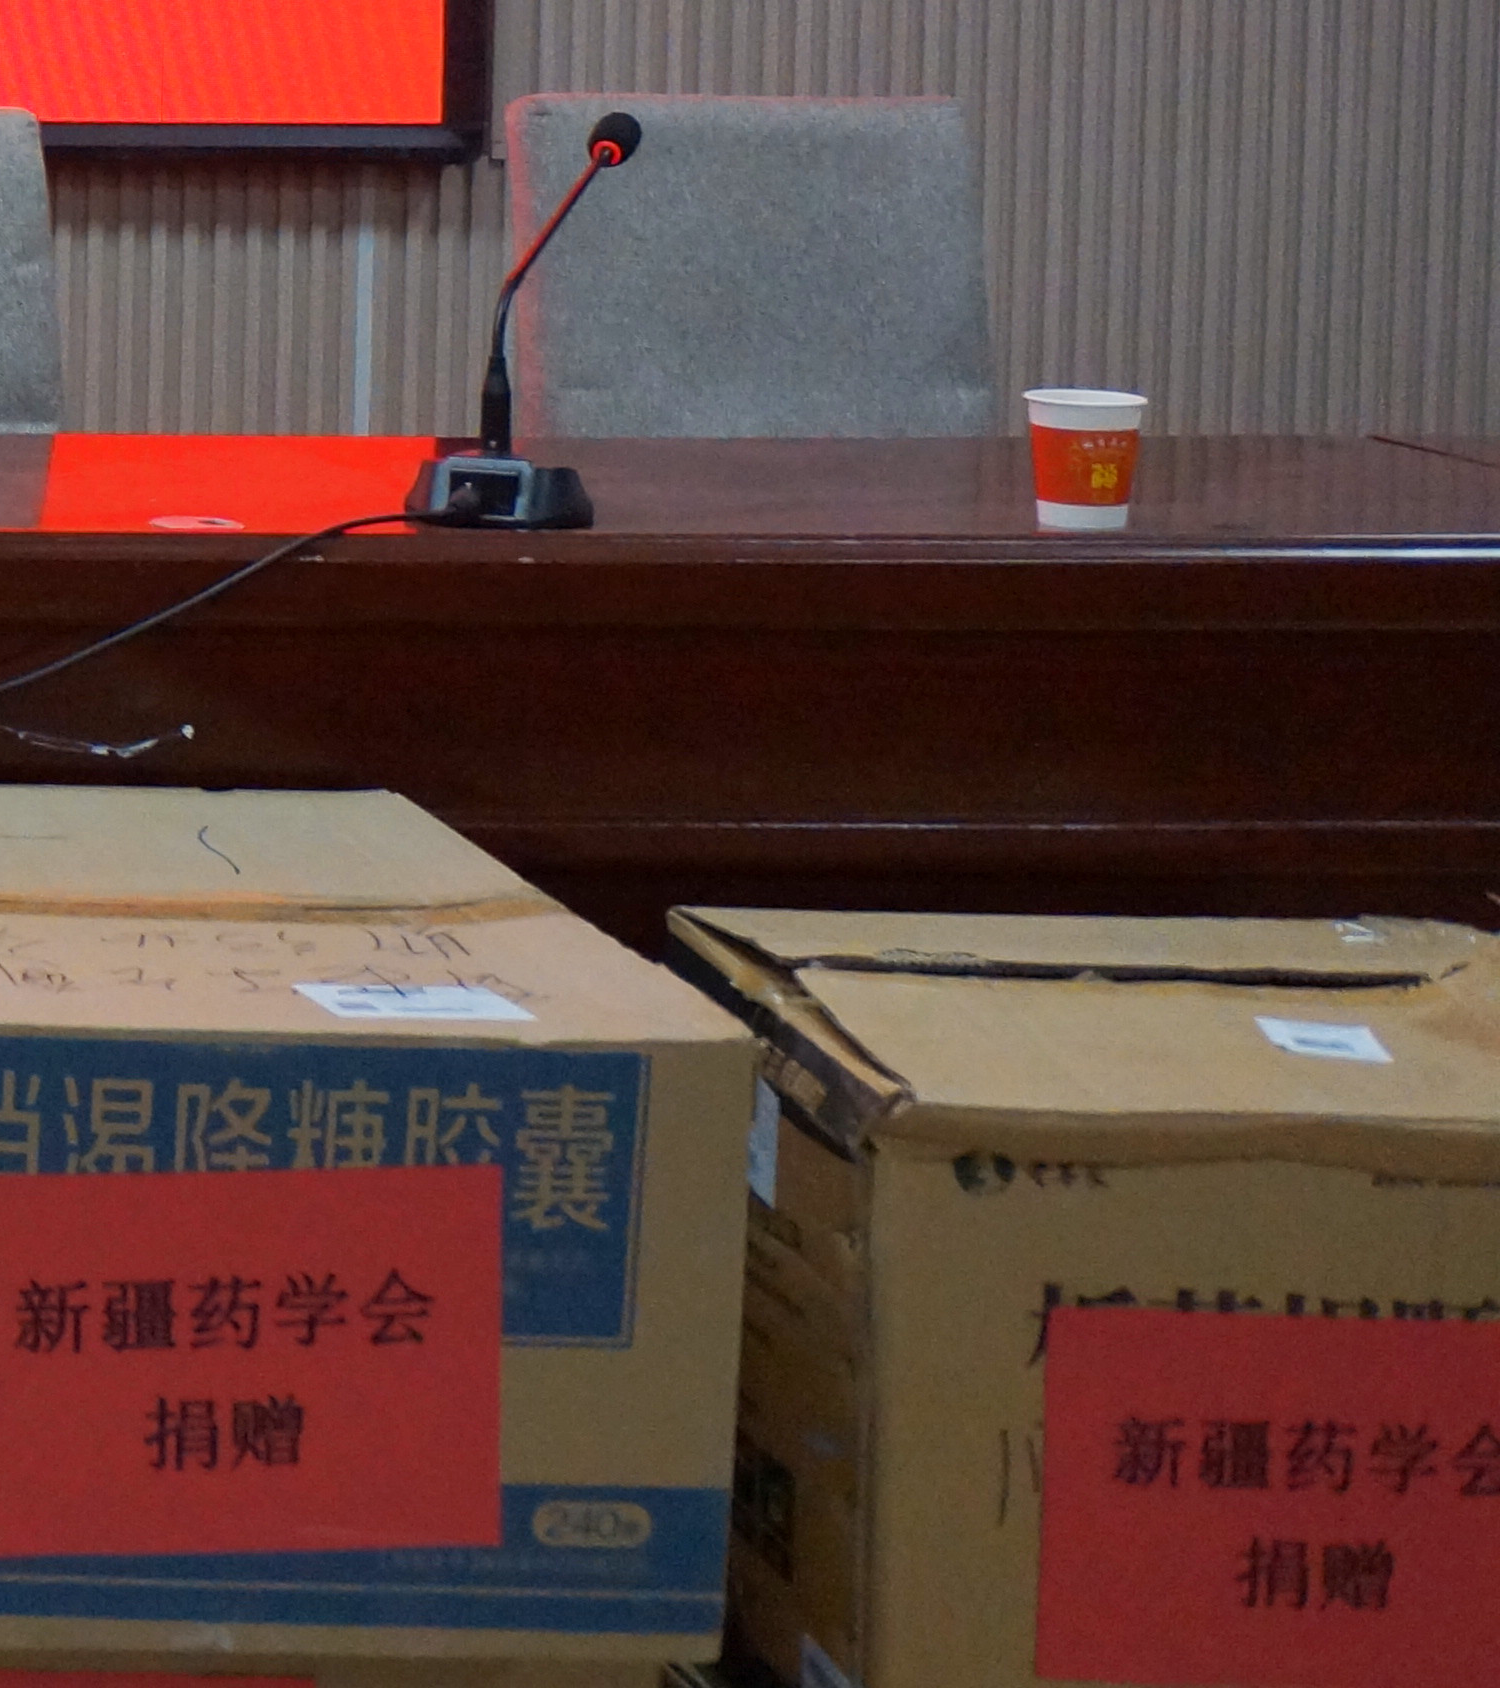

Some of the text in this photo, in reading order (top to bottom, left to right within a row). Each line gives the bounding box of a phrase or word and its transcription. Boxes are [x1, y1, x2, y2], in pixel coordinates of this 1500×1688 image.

[16, 1269, 434, 1354] 新疆药学会
[144, 1395, 305, 1471] 捐赠
[1237, 1537, 1396, 1610] 捐赠
